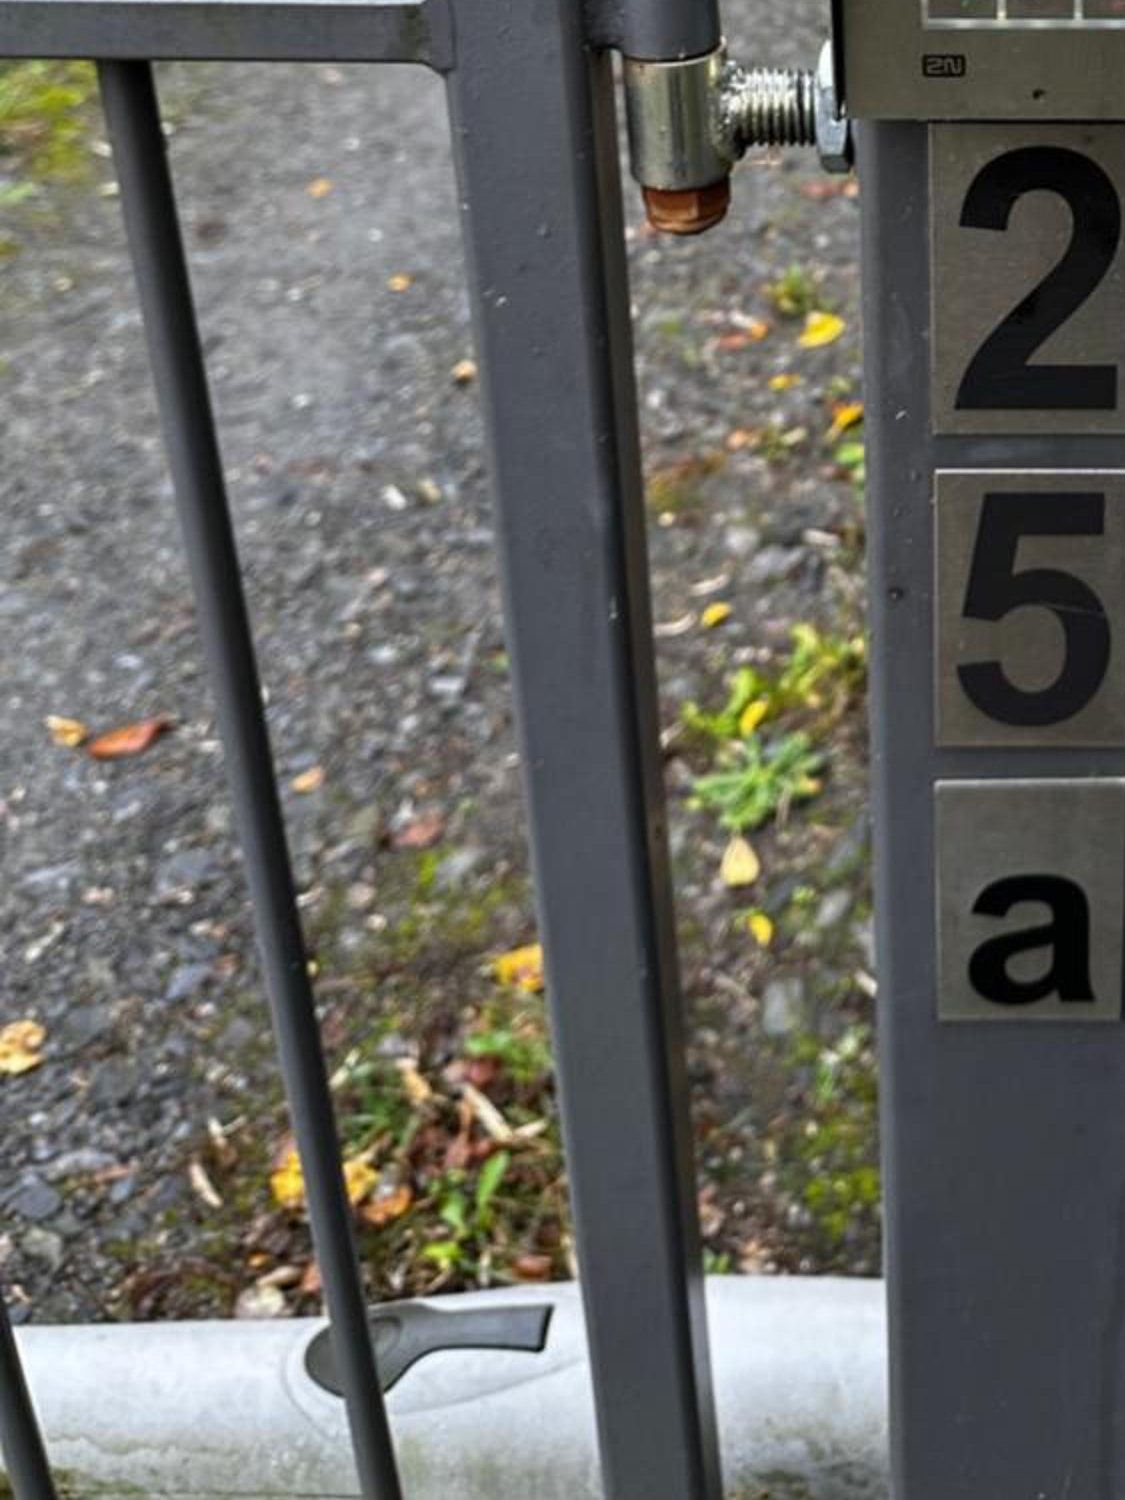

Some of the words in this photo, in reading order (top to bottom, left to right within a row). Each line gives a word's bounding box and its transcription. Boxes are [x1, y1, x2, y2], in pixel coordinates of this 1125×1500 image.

[926, 57, 962, 75] 2N
[954, 145, 1121, 411] 2
[955, 491, 1112, 727] 5
[967, 874, 1095, 1006] a
